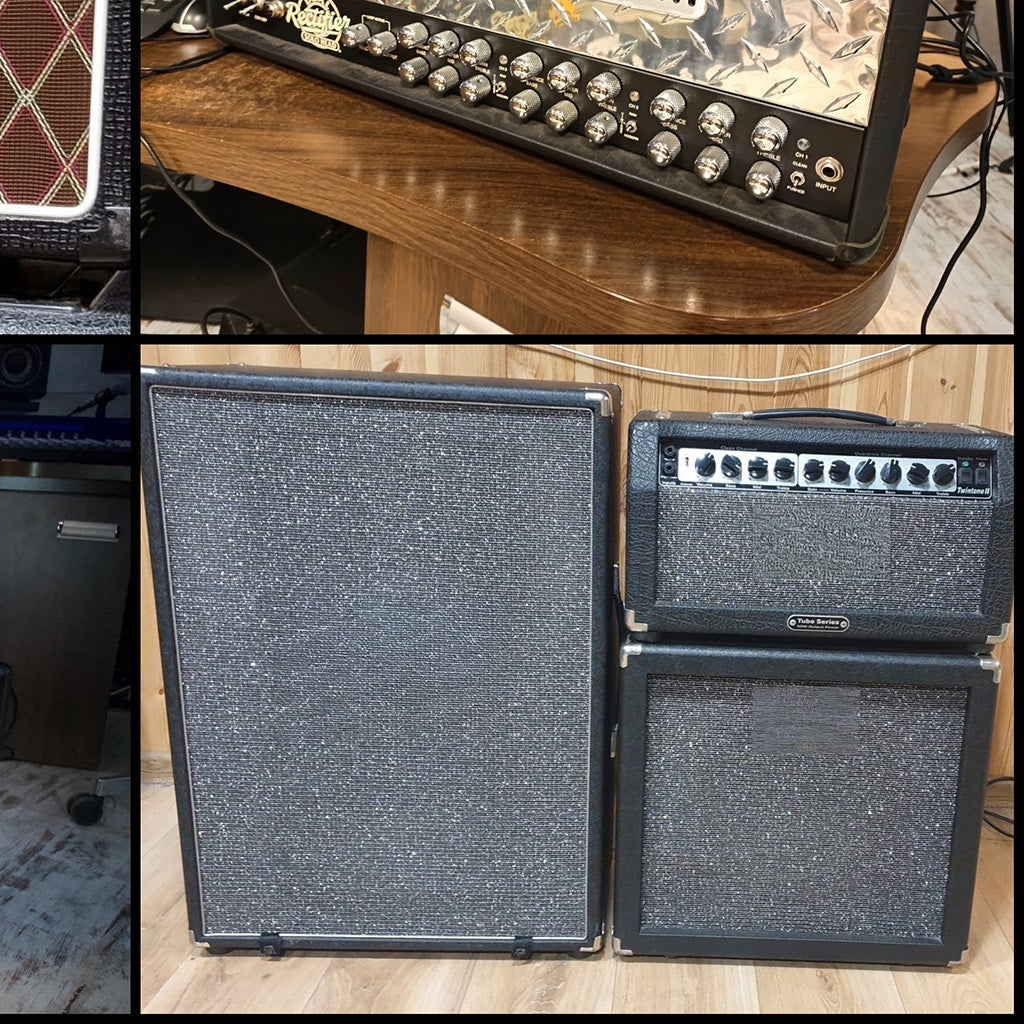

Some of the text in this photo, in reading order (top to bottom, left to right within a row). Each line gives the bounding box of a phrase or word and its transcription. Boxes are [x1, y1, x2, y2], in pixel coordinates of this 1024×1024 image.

[285, 2, 352, 38] Rectifier
[792, 160, 808, 169] CLEAN
[815, 181, 837, 193] INPUT
[957, 487, 984, 495] Twintone
